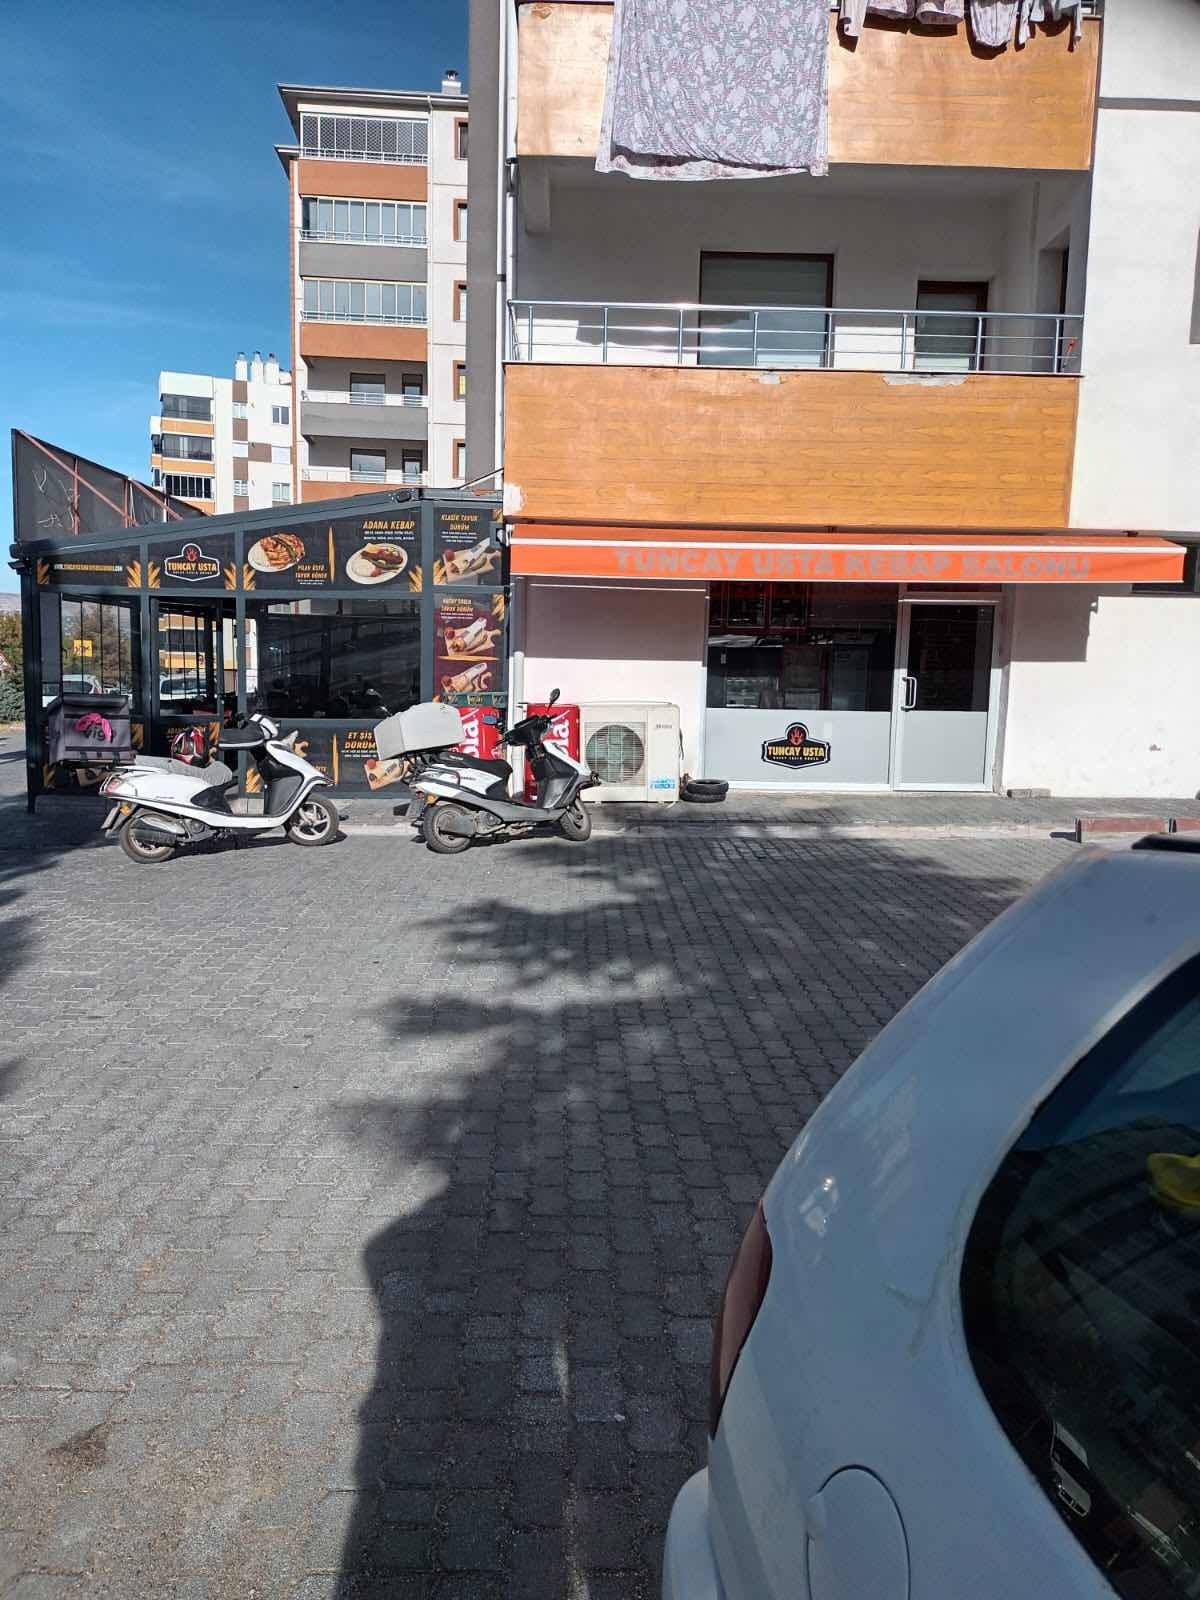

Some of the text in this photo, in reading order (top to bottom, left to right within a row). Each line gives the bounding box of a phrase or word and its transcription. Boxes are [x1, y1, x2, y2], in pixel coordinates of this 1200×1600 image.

[363, 520, 415, 530] ADANA KEBAP
[167, 562, 217, 572] TUNCAY USTA
[615, 549, 1090, 578] TUNCAY USTA KEBAP SALONU
[347, 731, 358, 739] ET
[767, 746, 825, 757] TUNCAY USTA
